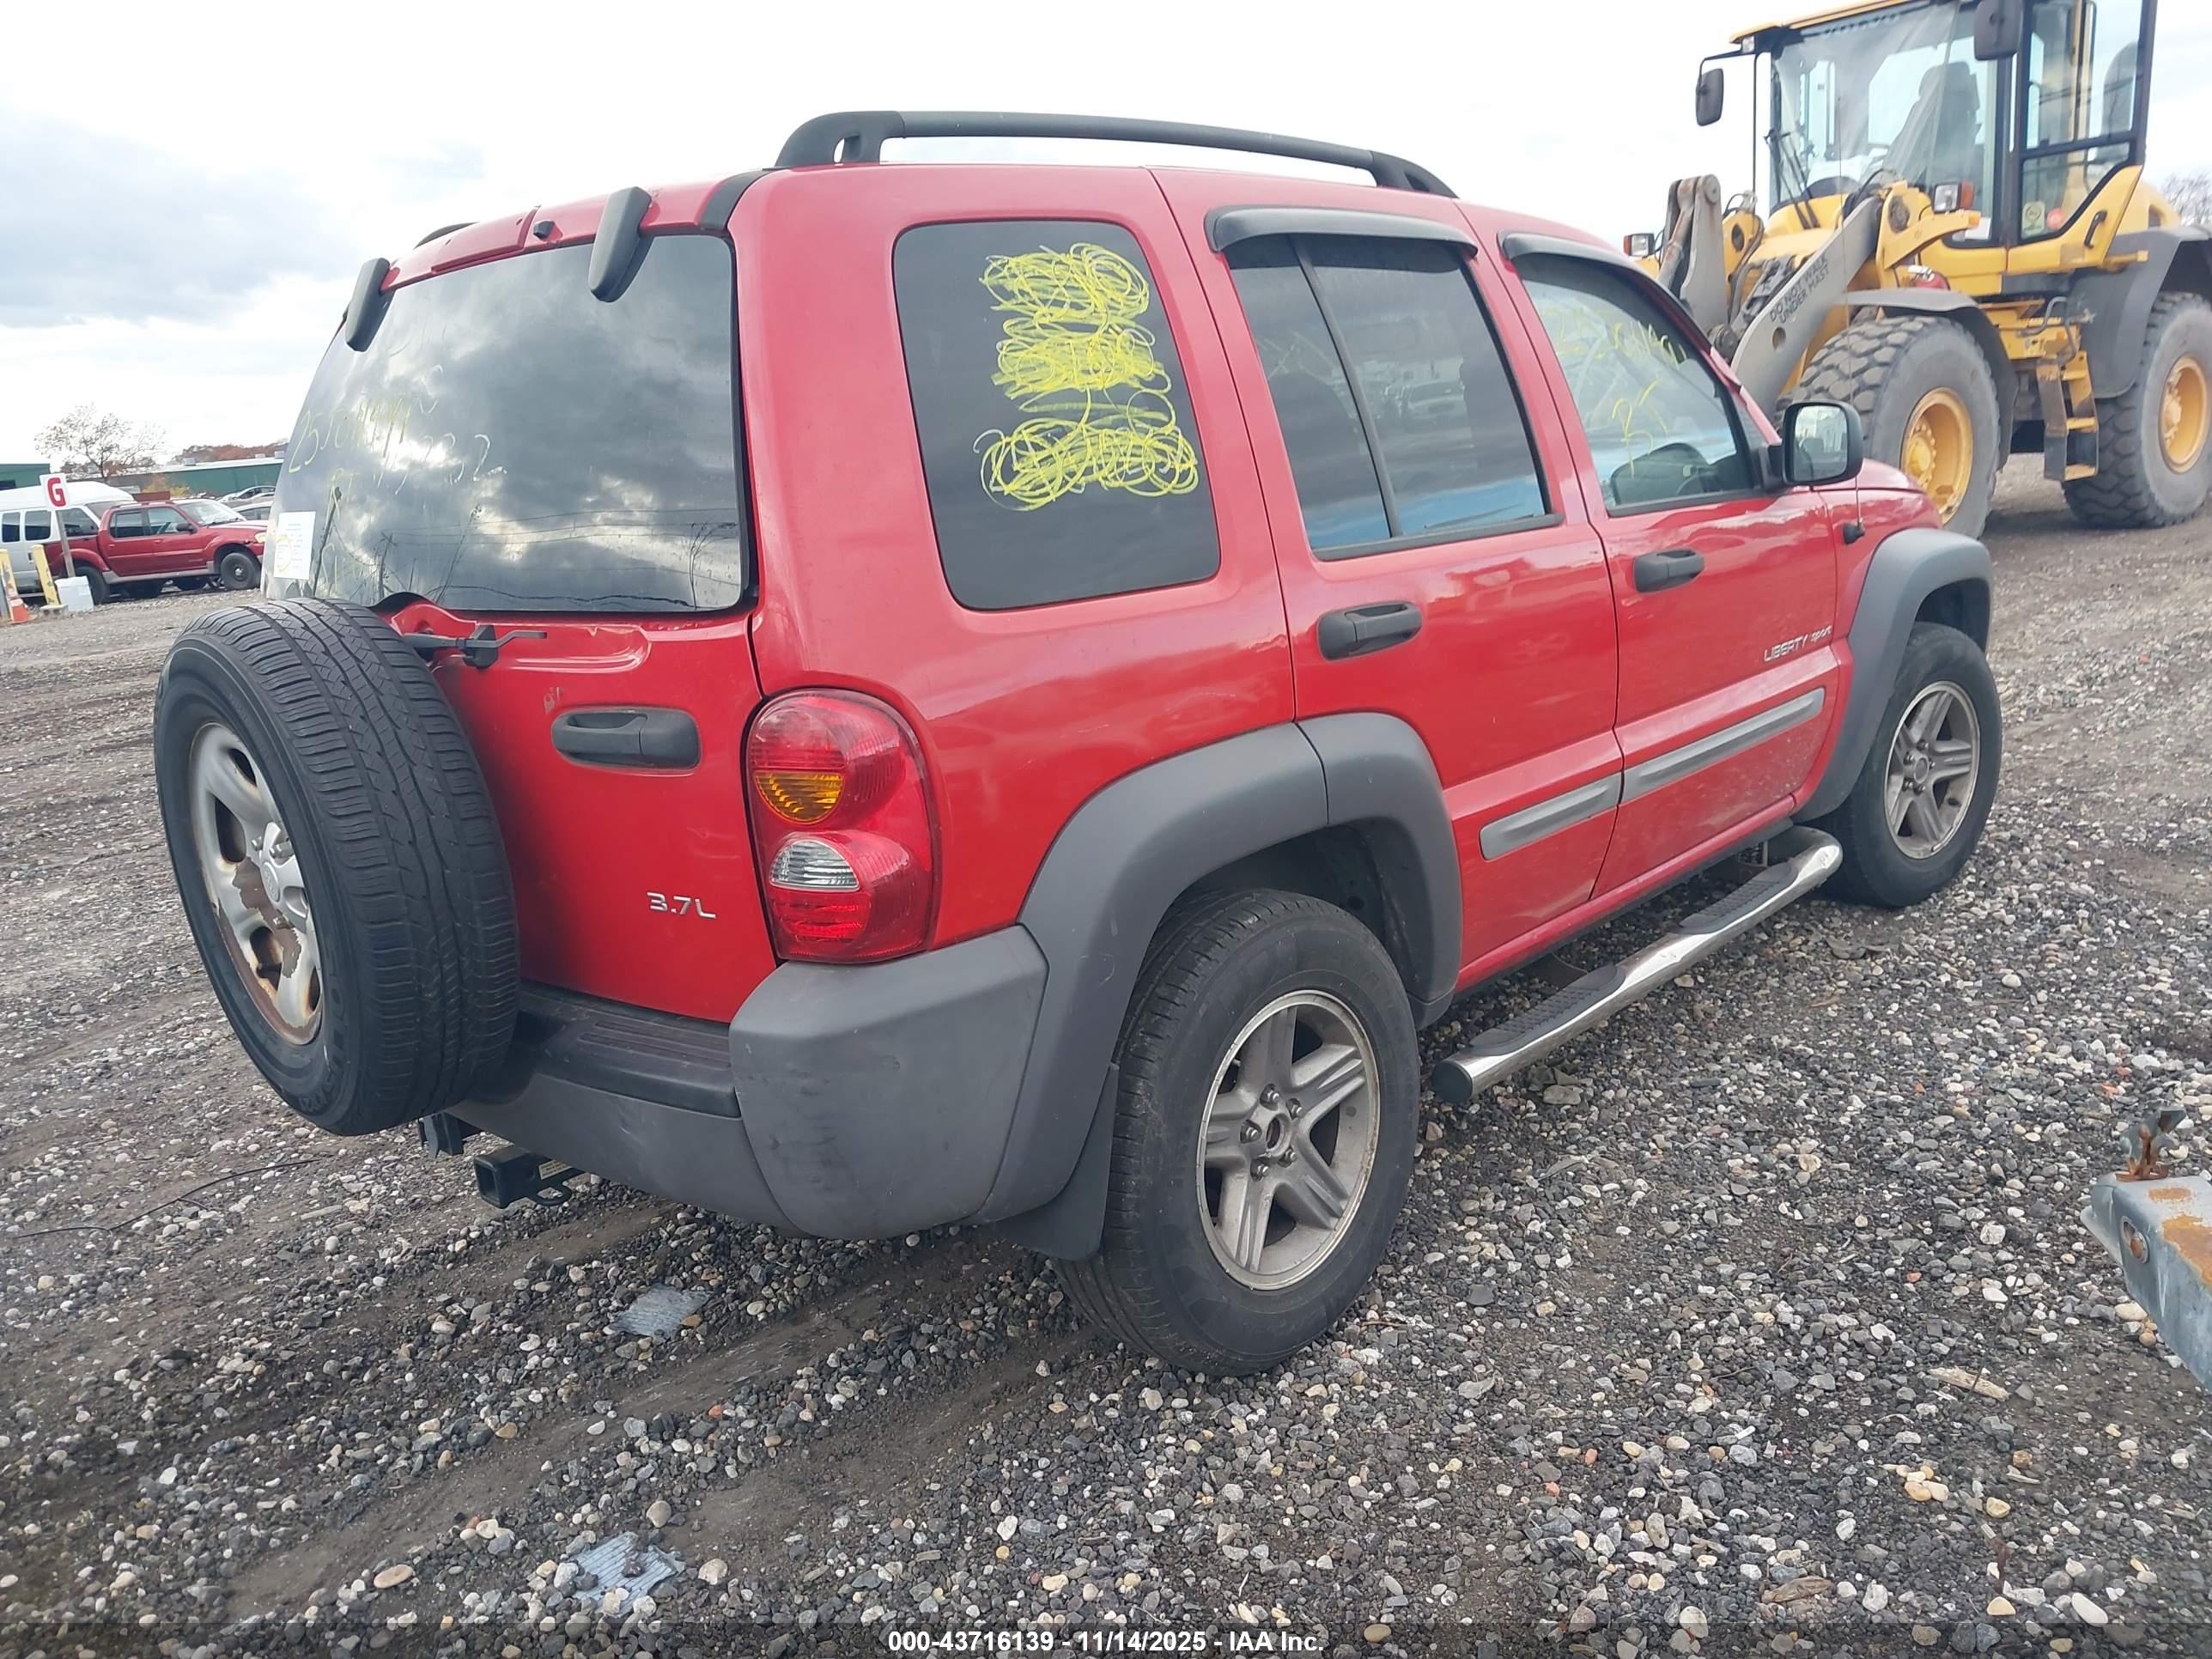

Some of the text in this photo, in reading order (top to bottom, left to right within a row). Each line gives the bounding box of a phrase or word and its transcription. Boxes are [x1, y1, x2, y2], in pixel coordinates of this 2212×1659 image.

[1770, 302, 1784, 322] DO
[1784, 279, 1801, 305] NOT
[1779, 263, 1829, 324] UNDER MAST
[47, 477, 66, 507] G
[1764, 634, 1808, 662] LIBERTY
[647, 891, 717, 919] 3.7L
